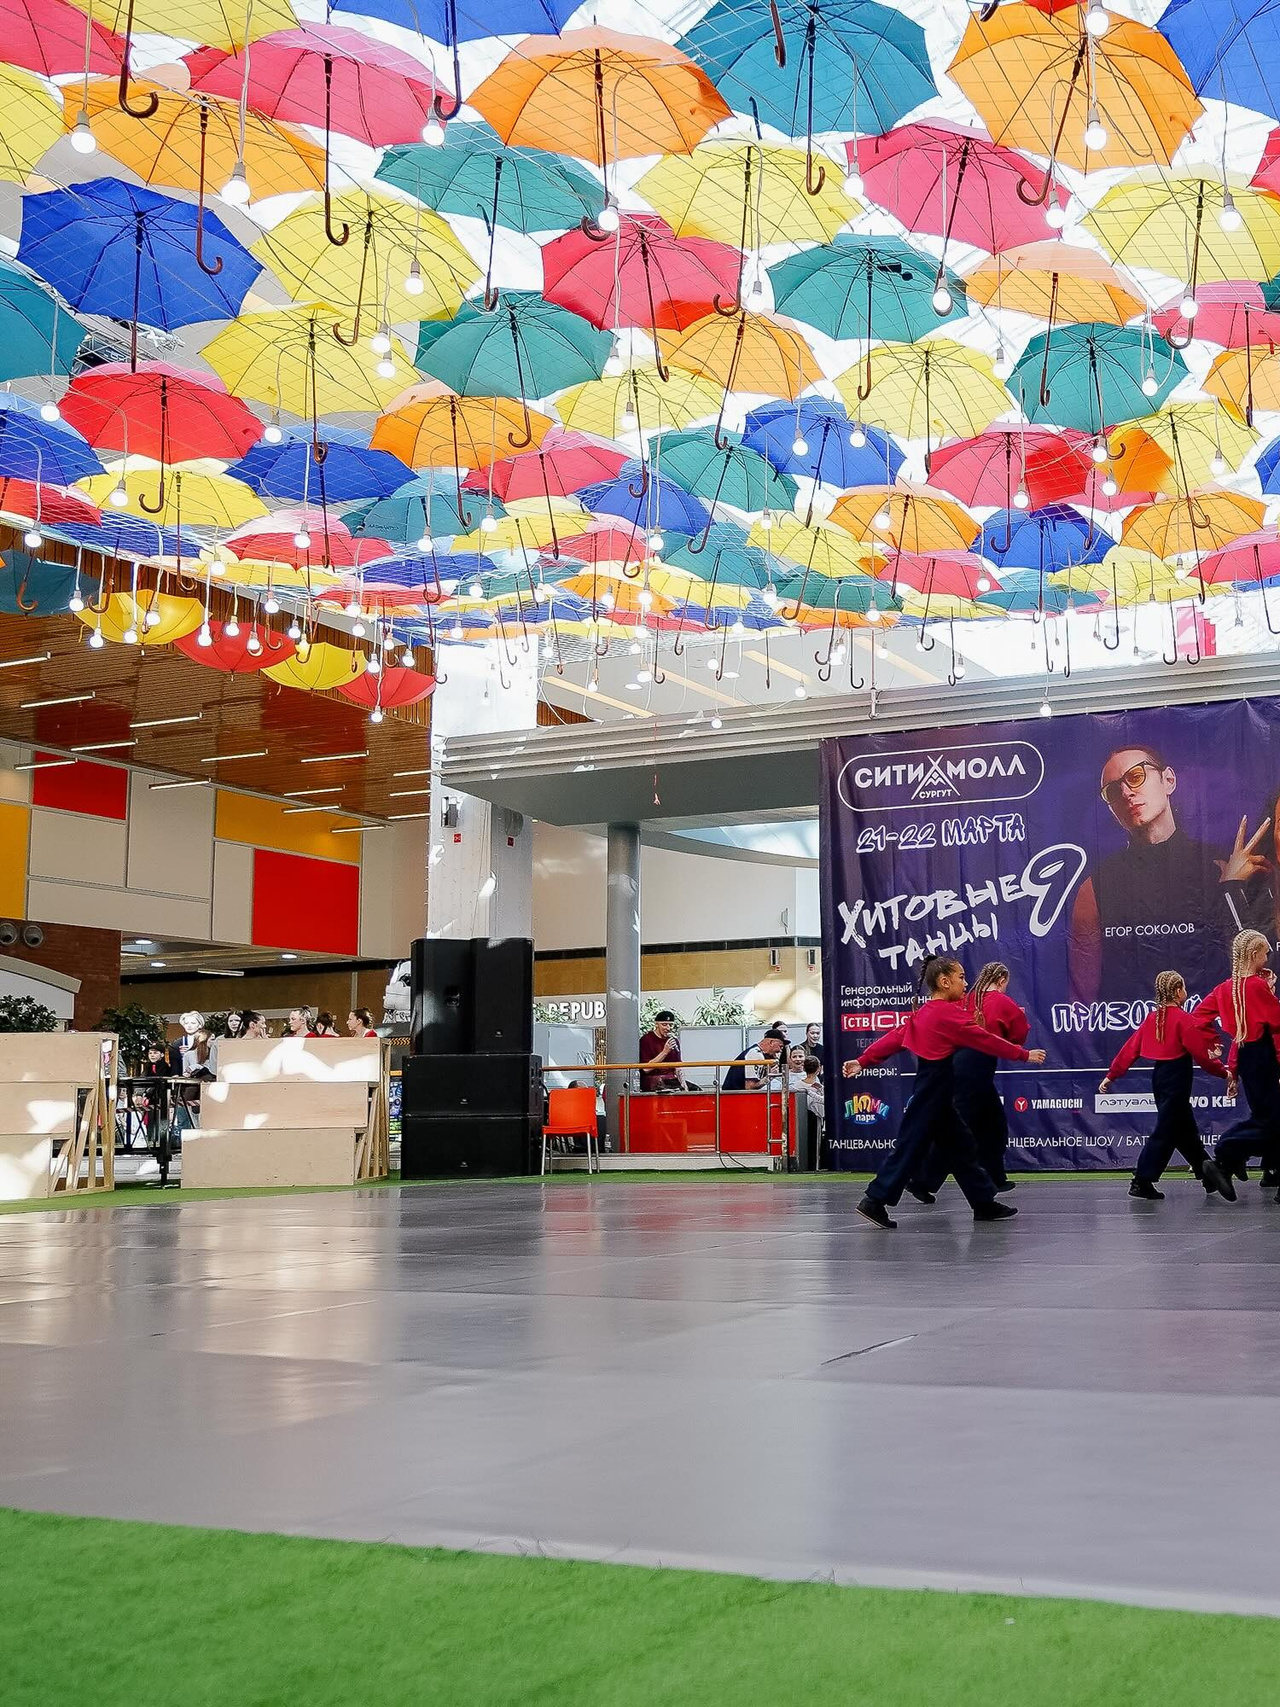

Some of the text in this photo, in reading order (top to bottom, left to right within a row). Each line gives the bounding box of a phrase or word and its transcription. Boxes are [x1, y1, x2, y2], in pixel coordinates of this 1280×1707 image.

[854, 755, 1026, 788] СИТИ МОЛЛ
[919, 789, 952, 799] СУРГУТ
[856, 813, 1026, 853] 21-22 МАРТА
[1105, 923, 1195, 937] ЕГОР СОКОЛОВ
[878, 913, 998, 970] ТАНЦЫ
[841, 981, 913, 996] Генеральный
[1031, 1098, 1083, 1110] YAMAGUCHI
[1005, 1136, 1083, 1149] НЦЕВАЛЬНОЕ
[1085, 1135, 1115, 1147] ШОУ
